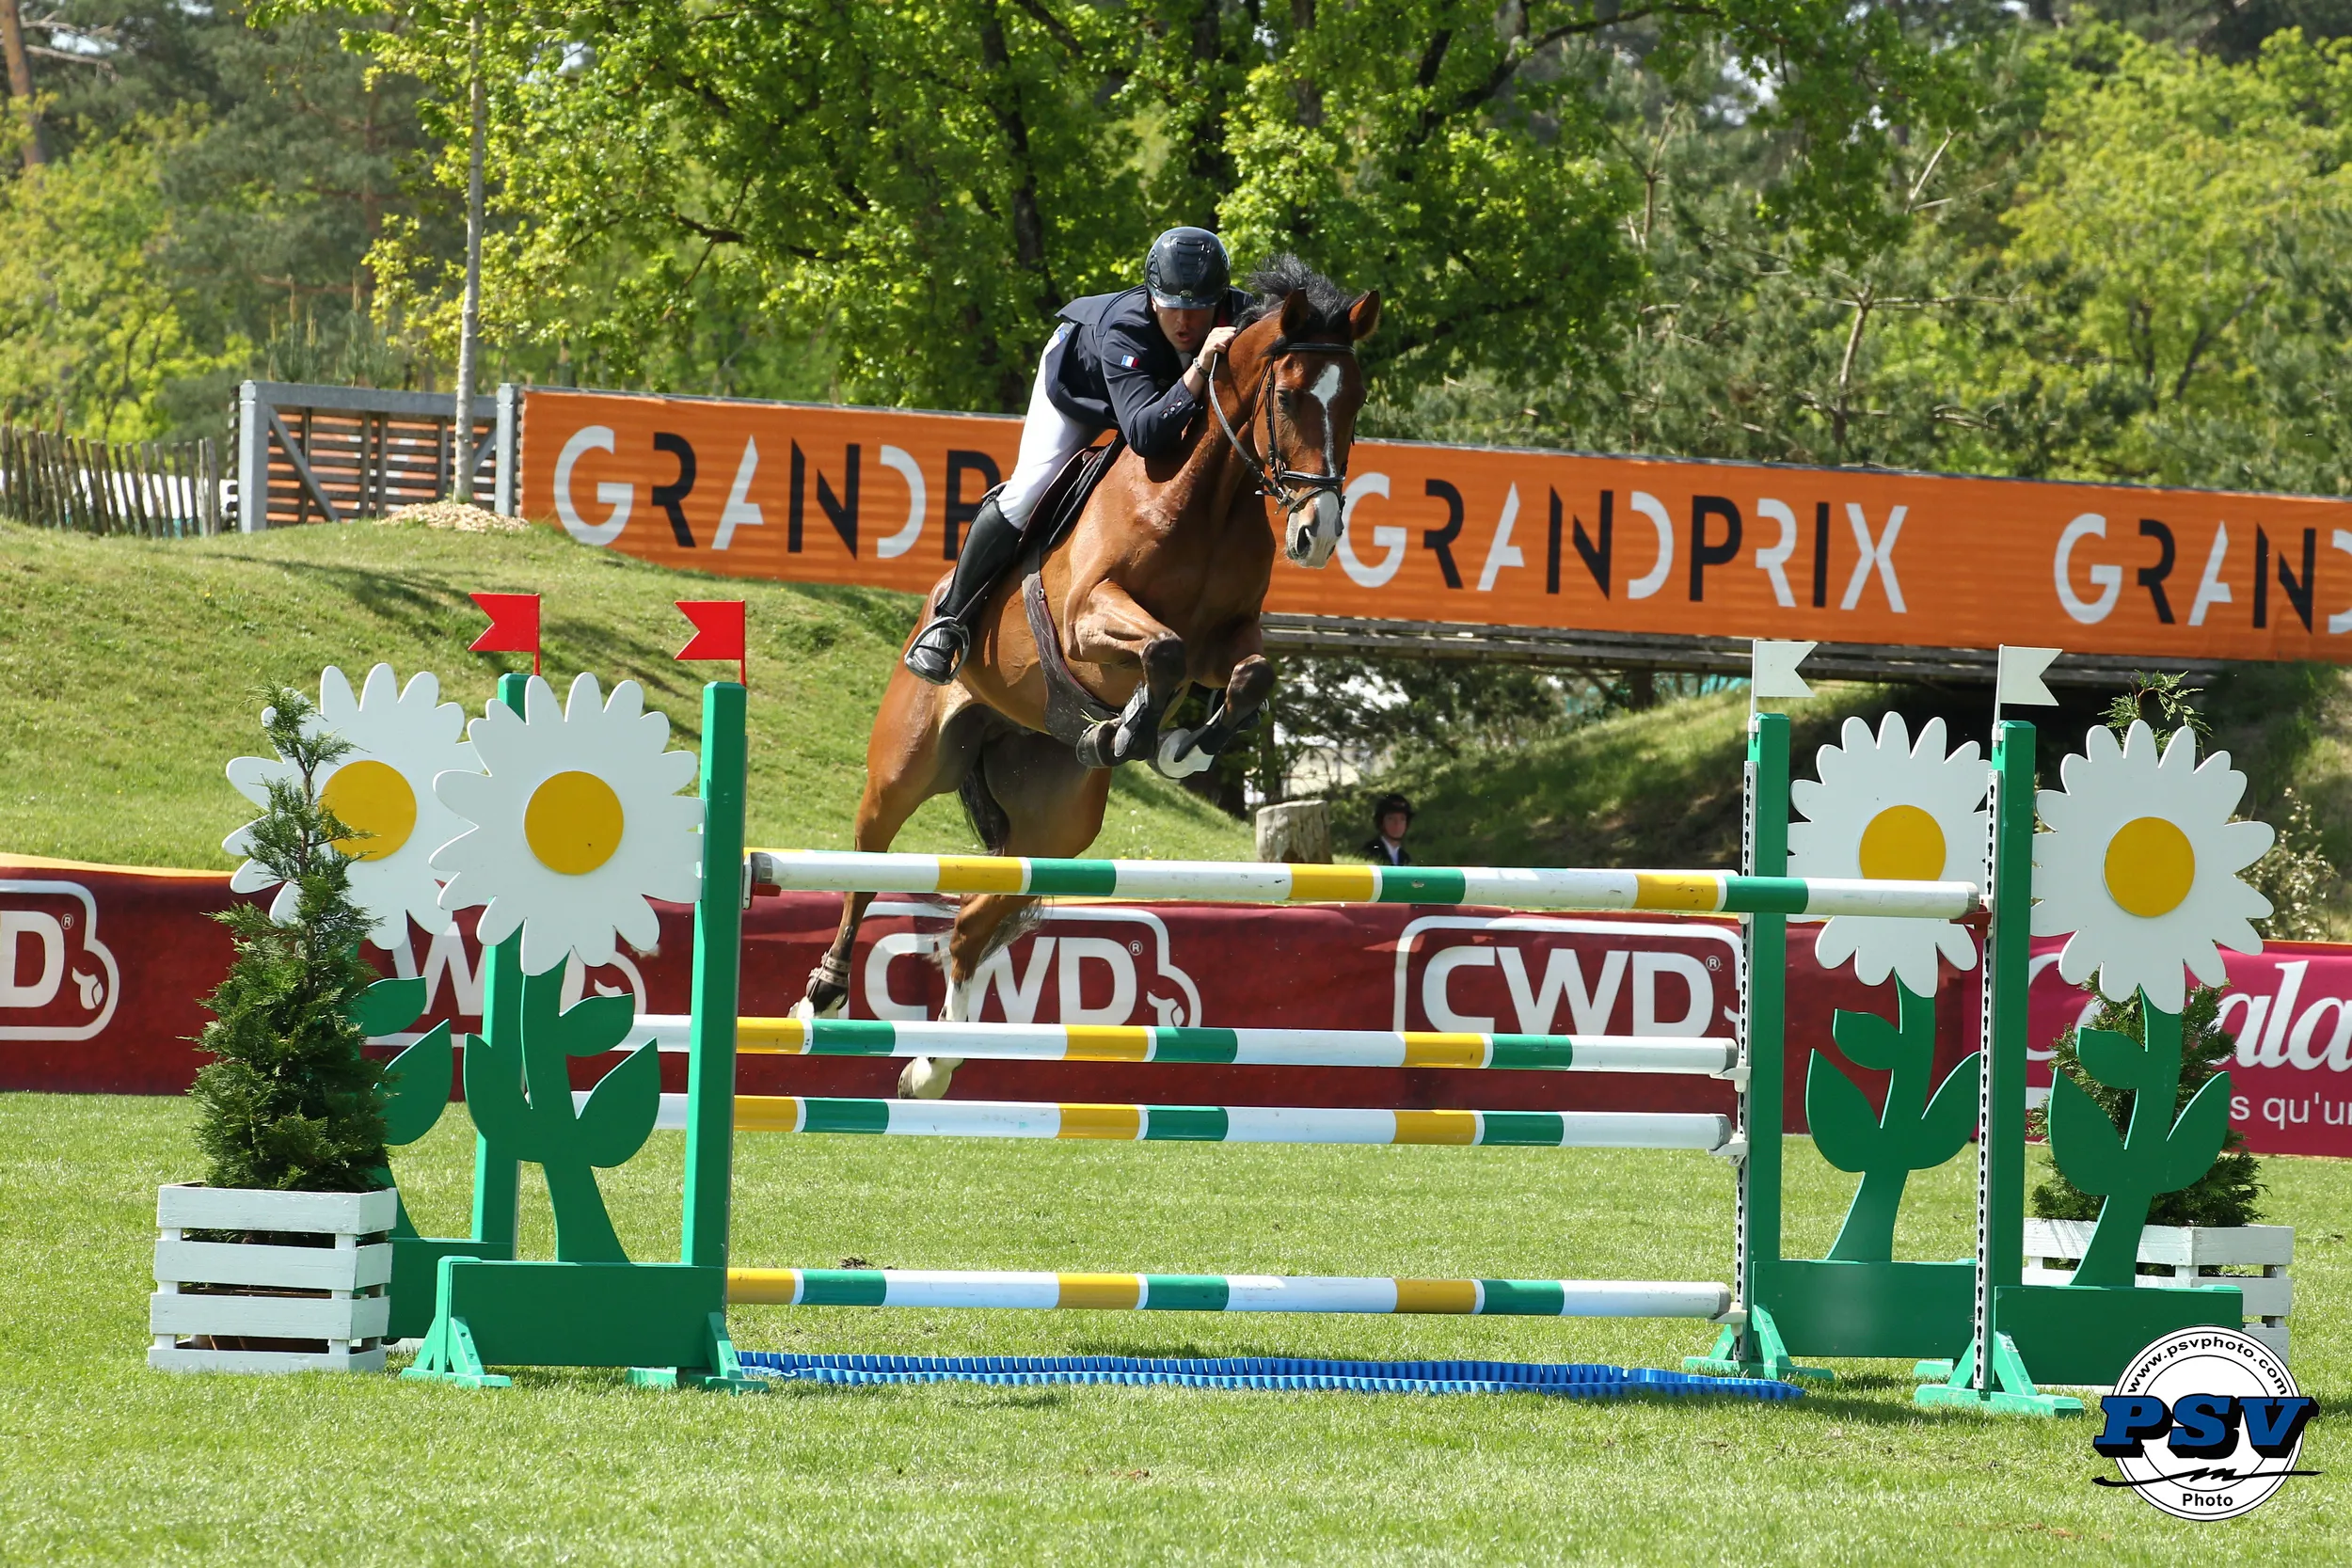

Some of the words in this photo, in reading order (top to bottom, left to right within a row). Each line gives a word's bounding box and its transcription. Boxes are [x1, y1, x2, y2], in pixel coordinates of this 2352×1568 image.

[553, 424, 1001, 561] GRANDP
[1336, 471, 1908, 614] GRANDPRIX
[2054, 513, 2352, 635] GRAND
[1422, 945, 1714, 1037] CWD
